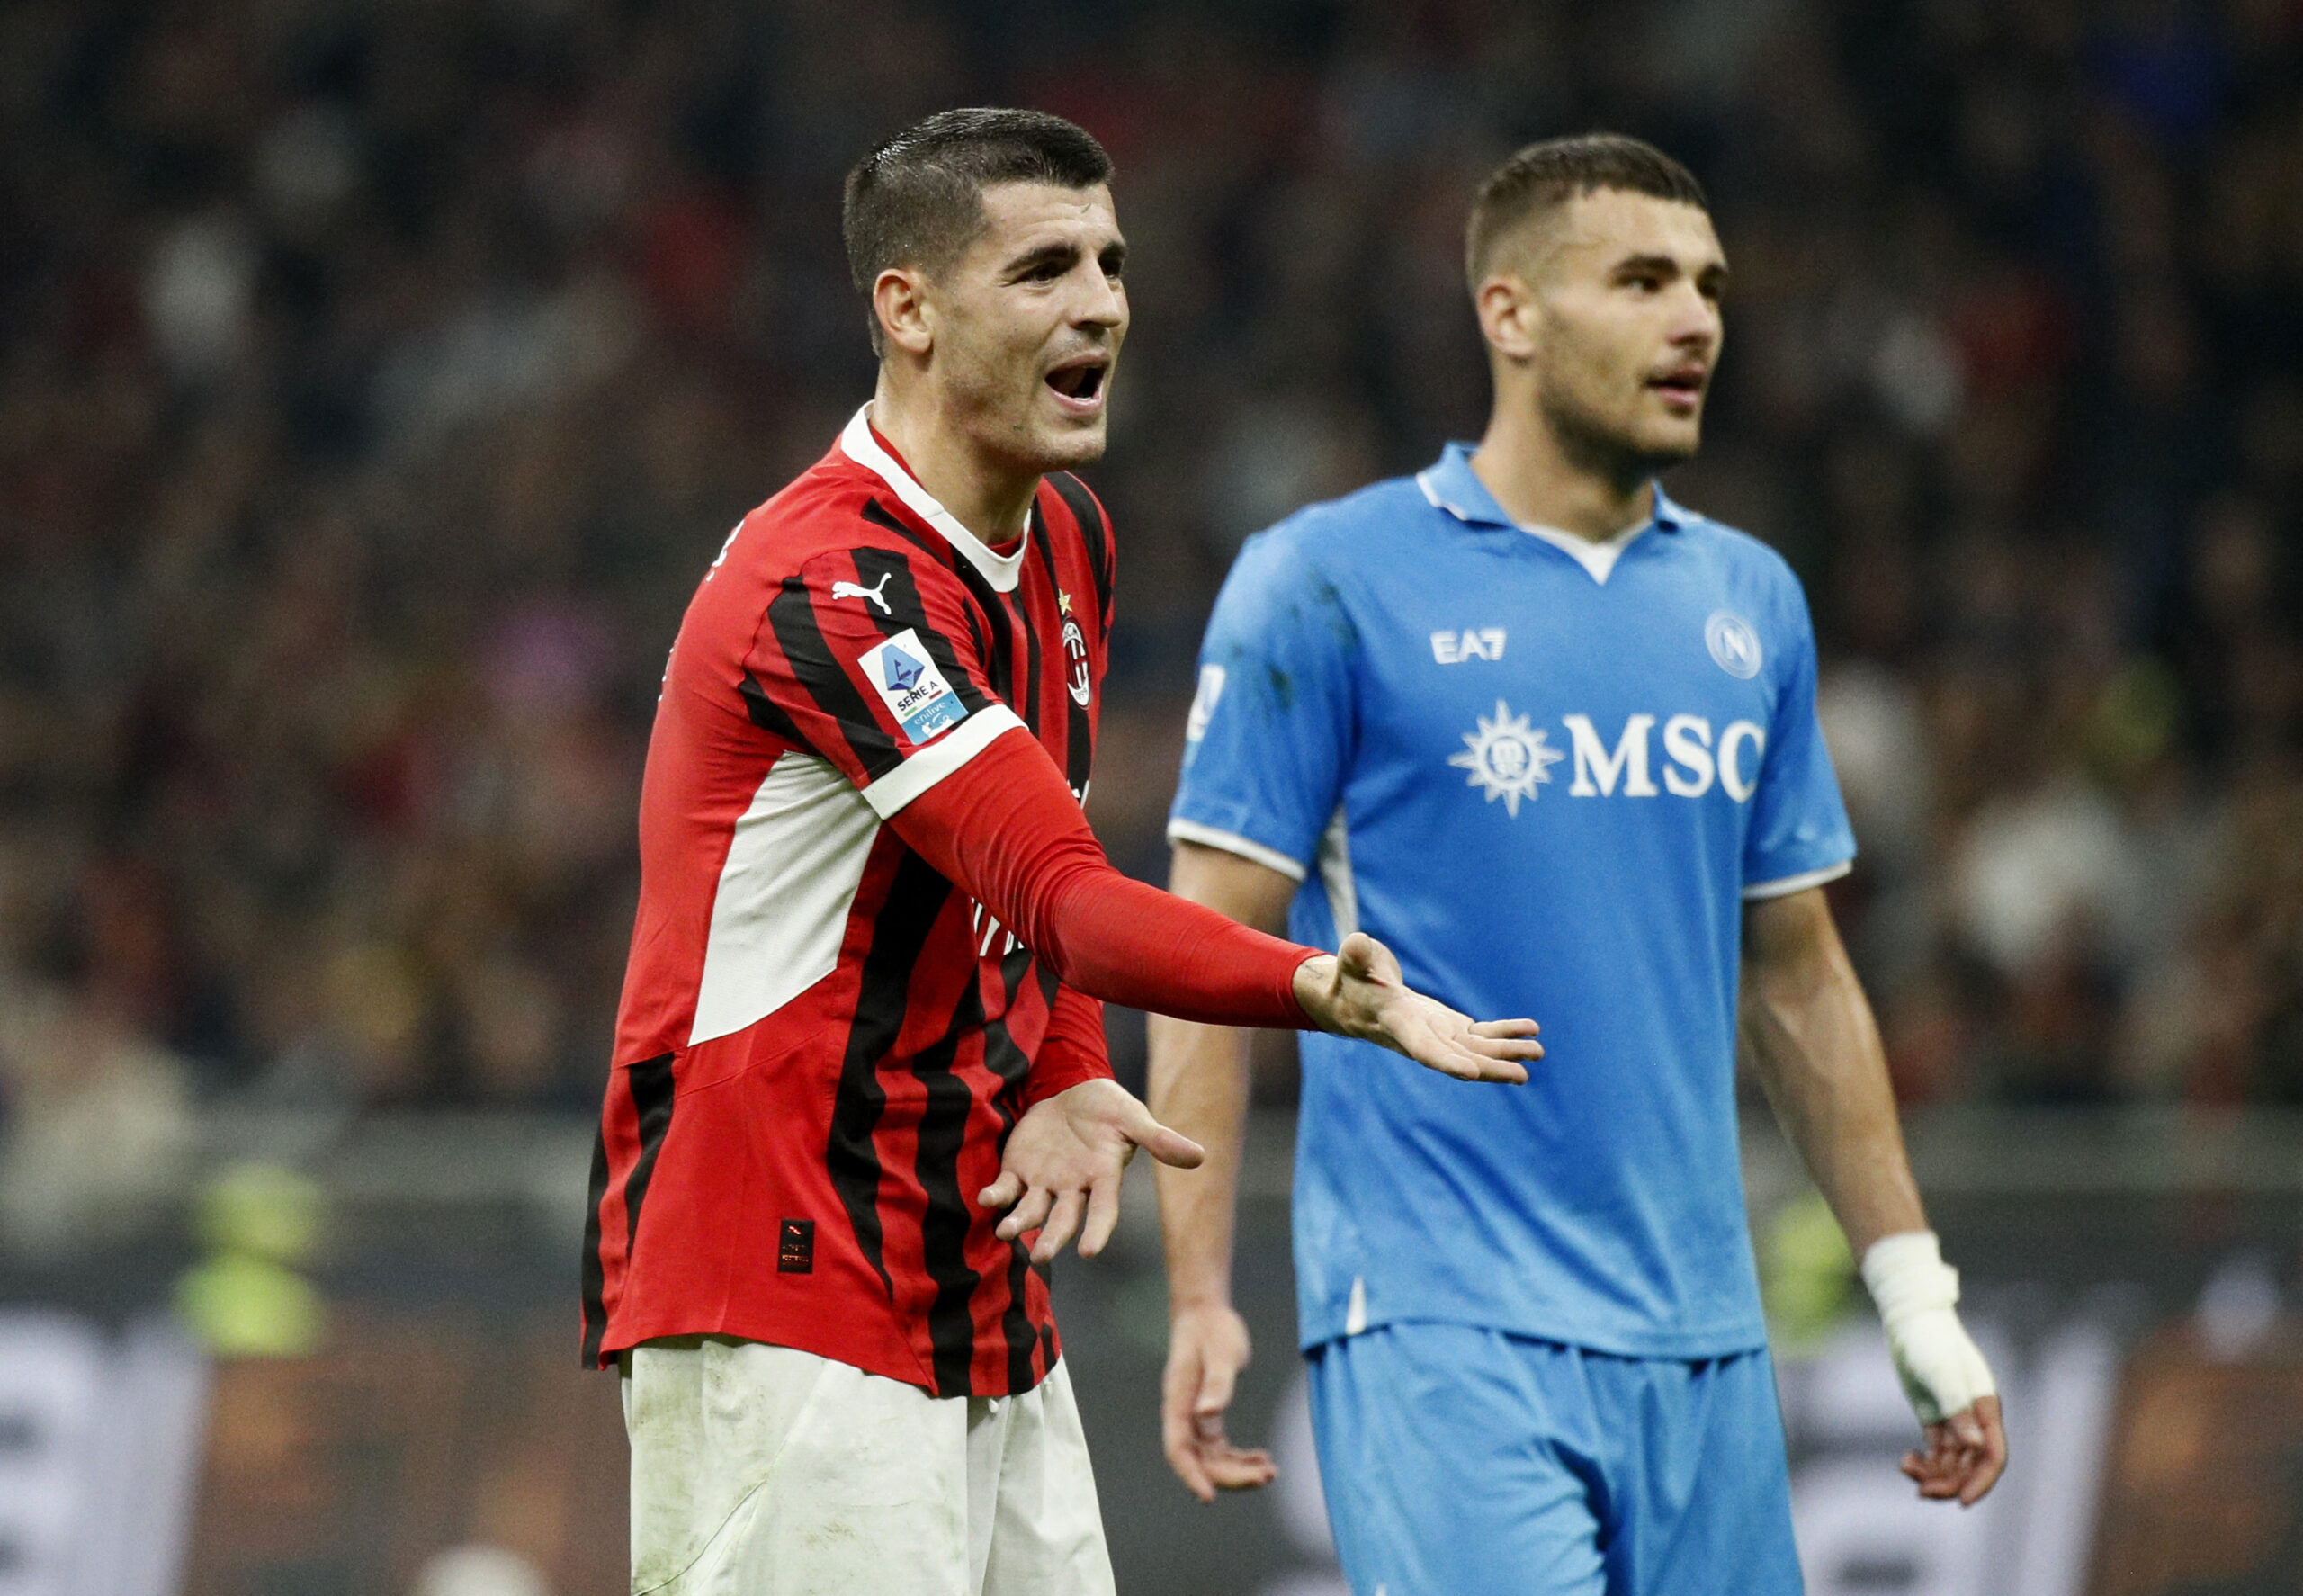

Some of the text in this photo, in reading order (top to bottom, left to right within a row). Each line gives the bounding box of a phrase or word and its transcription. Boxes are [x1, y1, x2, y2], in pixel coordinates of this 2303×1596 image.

[1430, 629, 1507, 664] EA7
[897, 680, 939, 711] SERIE A
[914, 702, 946, 725] enilive
[1563, 713, 1766, 803] MSC
